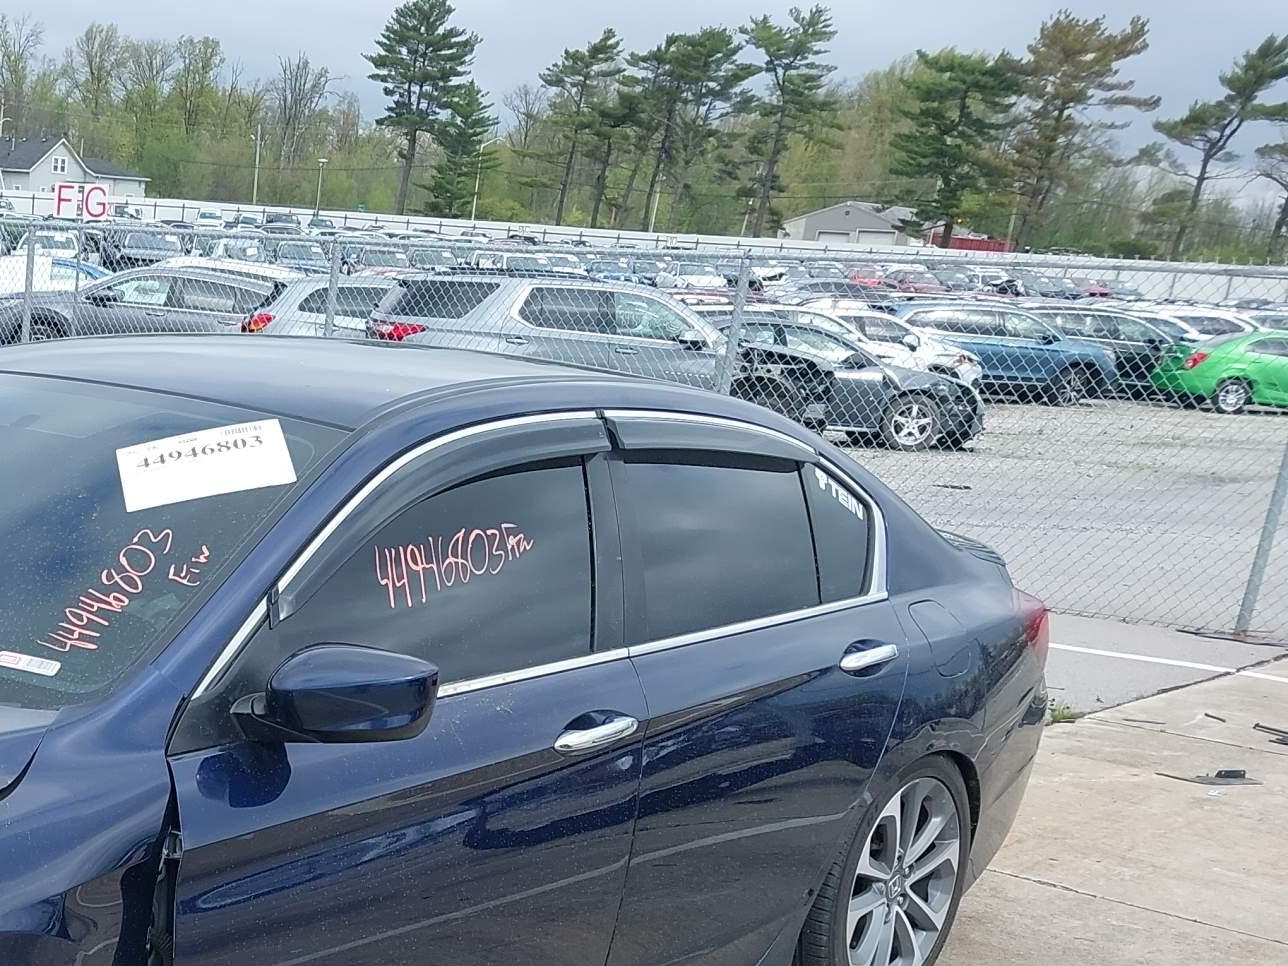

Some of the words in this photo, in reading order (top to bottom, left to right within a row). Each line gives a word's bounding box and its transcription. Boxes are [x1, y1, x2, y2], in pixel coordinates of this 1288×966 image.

[136, 435, 264, 469] 44946803
[828, 477, 864, 521] TEIN
[34, 528, 173, 652] 44946803
